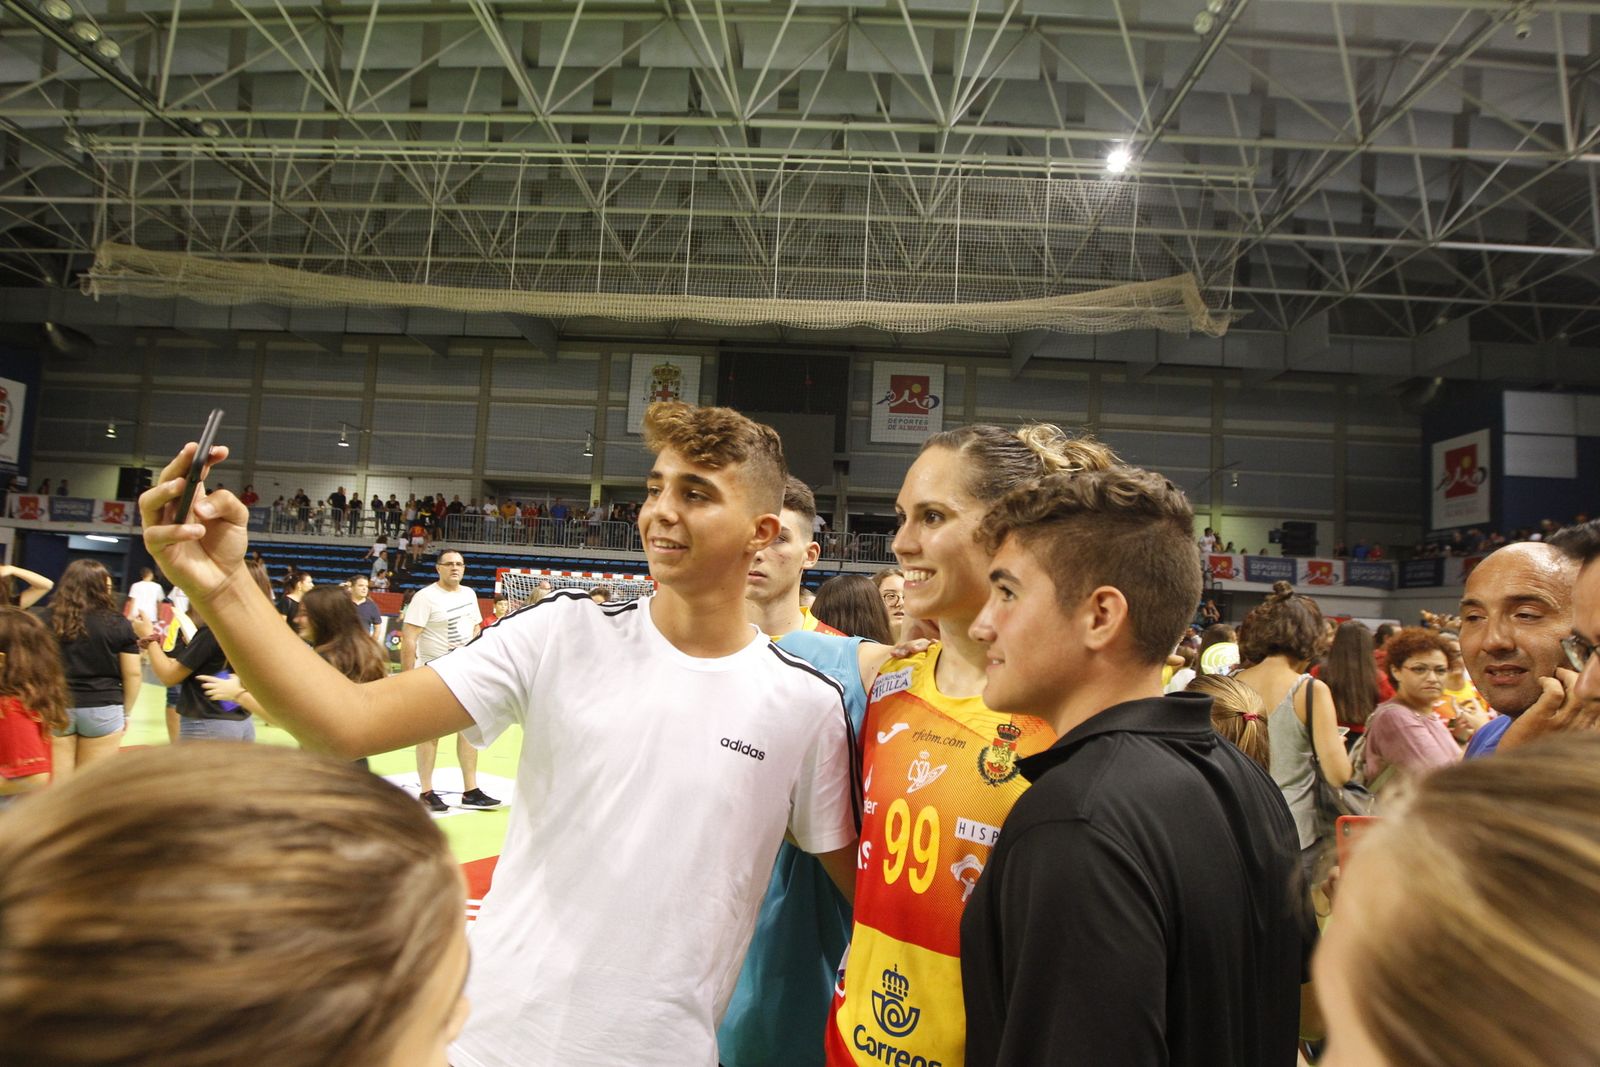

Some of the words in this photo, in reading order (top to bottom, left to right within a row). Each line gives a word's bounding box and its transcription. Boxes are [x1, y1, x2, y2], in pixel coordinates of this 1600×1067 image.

[720, 737, 765, 761] adidas
[912, 730, 967, 749] rfebm.com
[883, 798, 941, 895] 99
